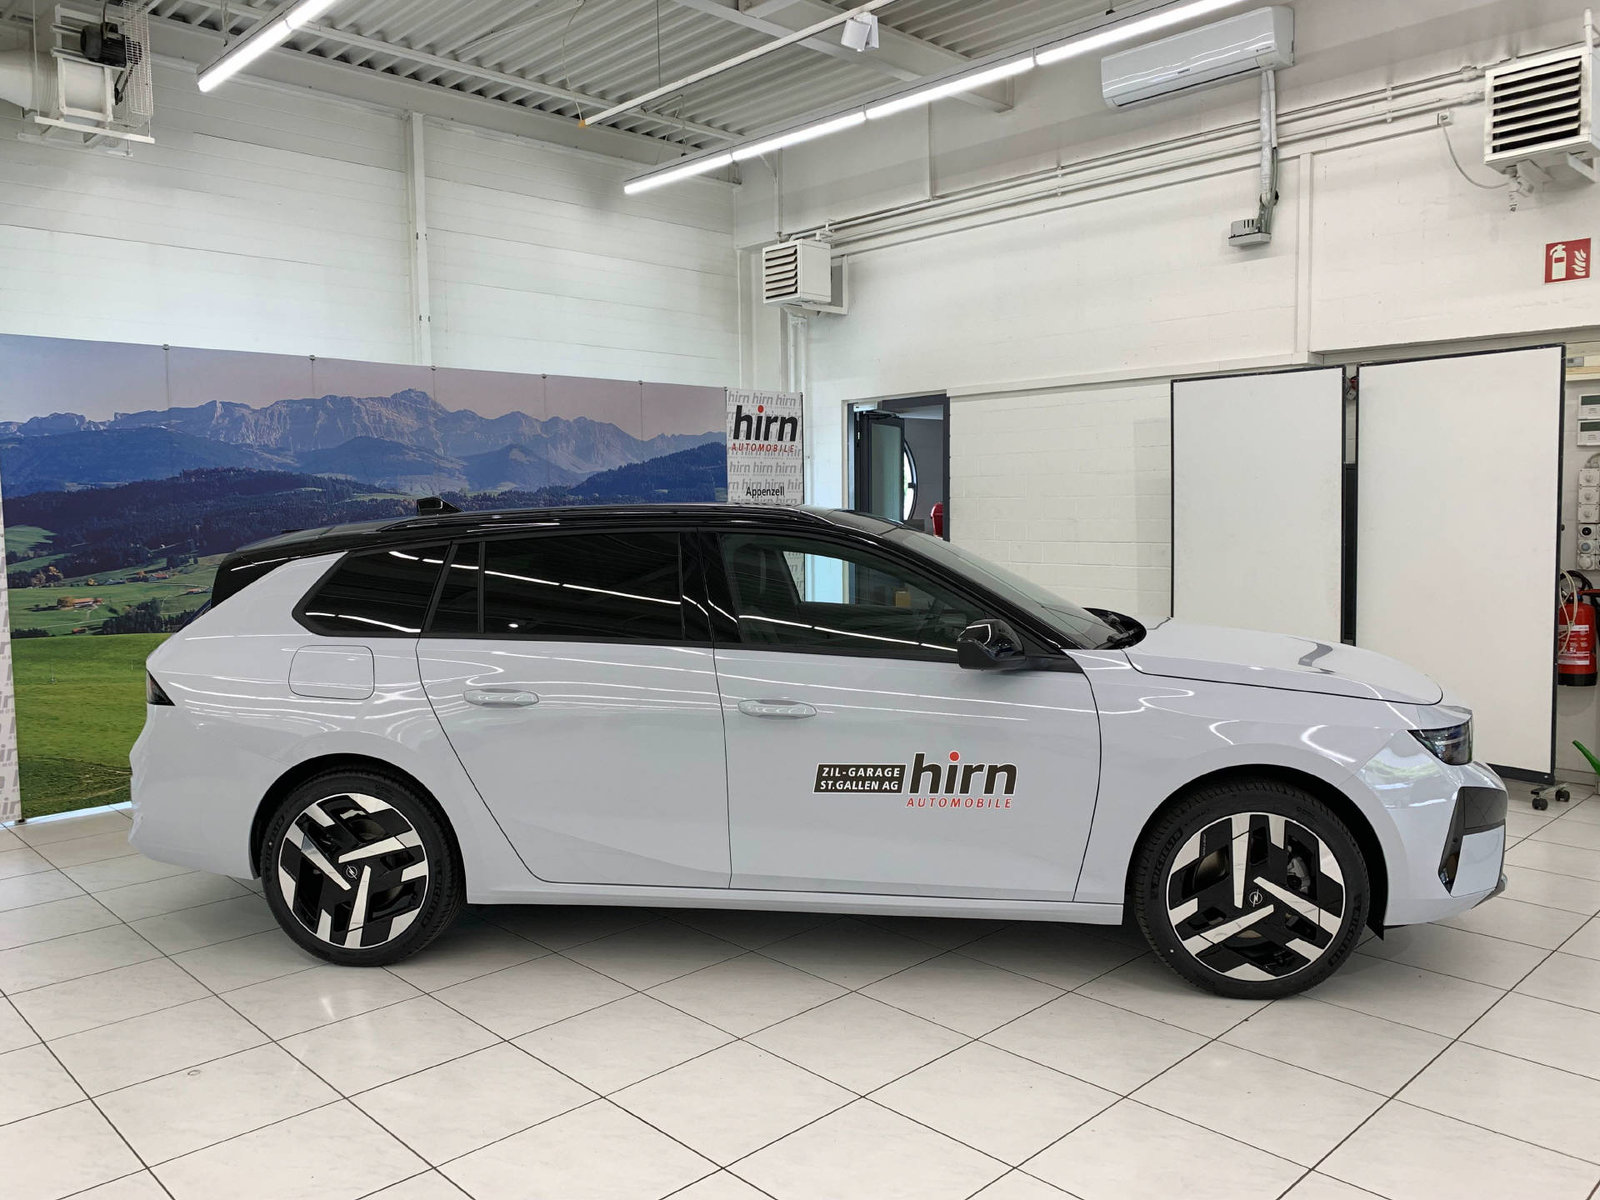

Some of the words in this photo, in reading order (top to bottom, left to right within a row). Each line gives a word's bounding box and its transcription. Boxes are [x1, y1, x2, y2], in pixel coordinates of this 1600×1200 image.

[729, 391, 750, 404] hirn
[752, 392, 773, 405] hirn
[775, 393, 796, 406] hirn
[733, 405, 798, 441] hirn
[731, 443, 795, 453] AUTOMOBILE
[729, 461, 751, 473] hirn
[753, 461, 773, 473] hirn
[775, 462, 797, 474] hirn
[746, 486, 785, 498] Appenzell
[822, 767, 900, 777] ZIL-GARAGE
[909, 751, 1017, 794] hirn
[820, 780, 879, 790] ST.GALLEN
[882, 781, 899, 790] AG
[906, 797, 1012, 808] AUTOMOBILE
